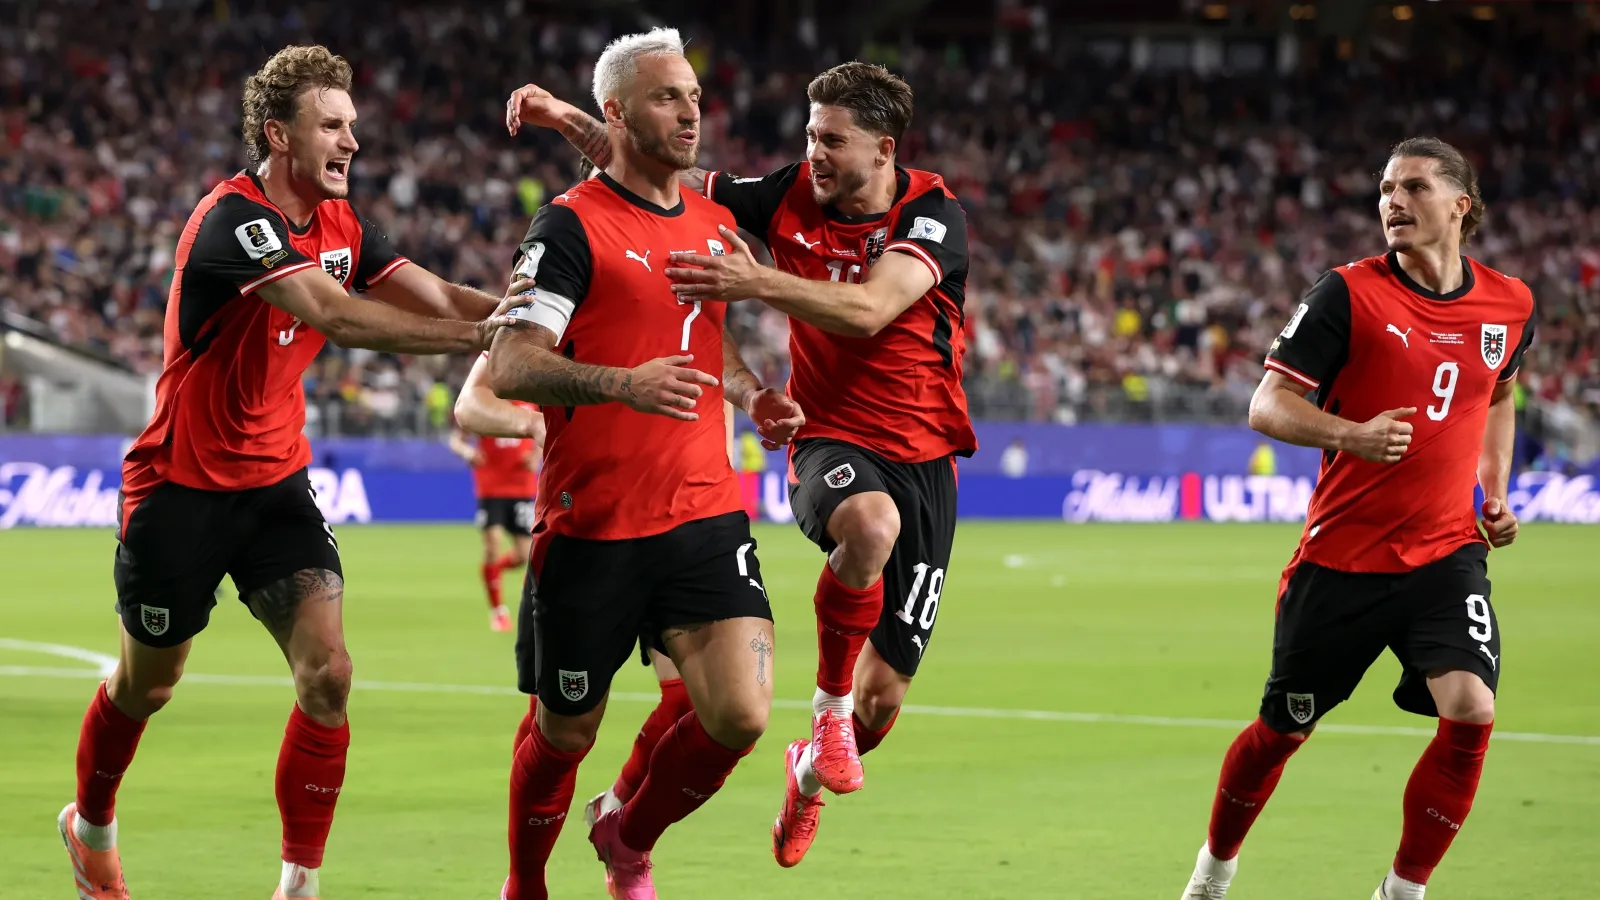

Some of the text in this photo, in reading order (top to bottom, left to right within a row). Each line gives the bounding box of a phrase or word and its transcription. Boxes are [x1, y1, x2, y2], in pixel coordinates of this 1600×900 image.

[1426, 361, 1460, 422] 9
[895, 562, 944, 631] 18
[1465, 593, 1492, 643] 9
[1426, 807, 1461, 831] ÖFB
